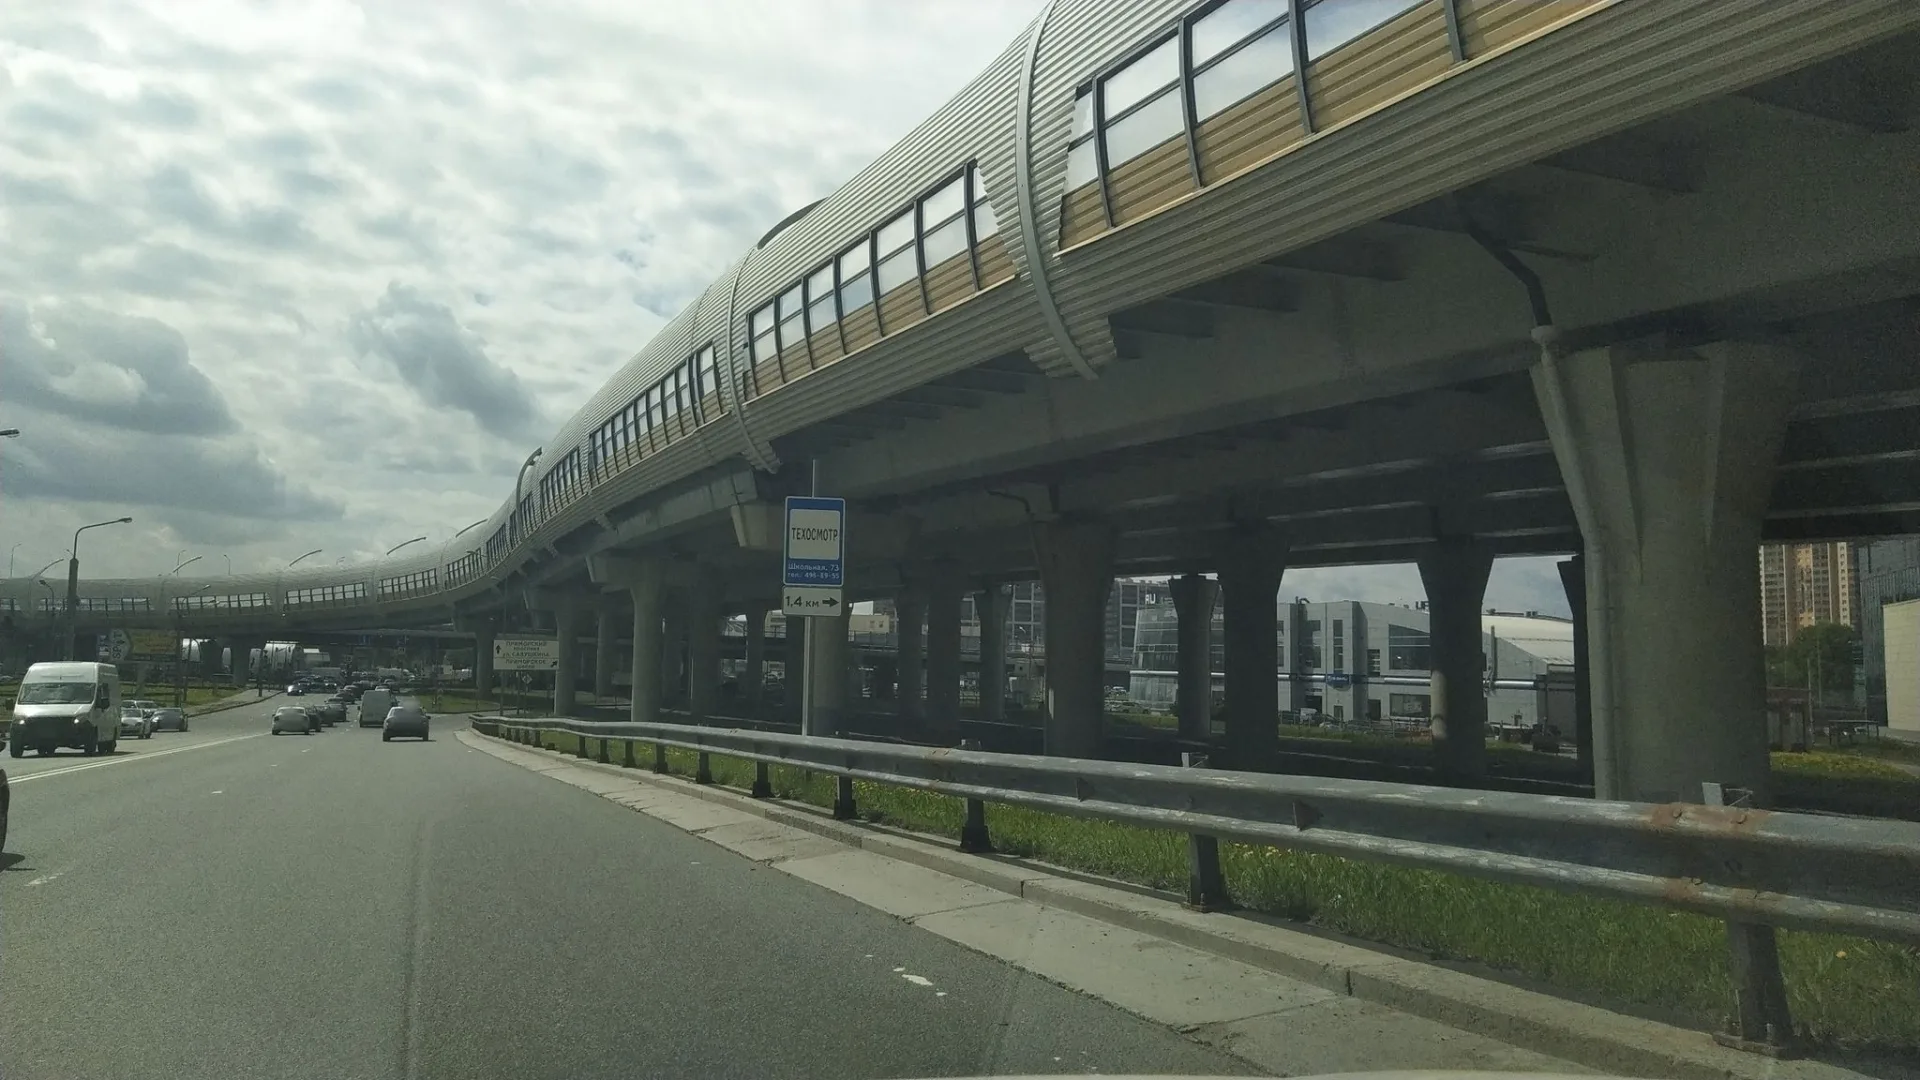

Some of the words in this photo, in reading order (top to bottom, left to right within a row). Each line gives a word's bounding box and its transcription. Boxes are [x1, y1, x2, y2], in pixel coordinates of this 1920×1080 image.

[791, 527, 838, 541] ТЕХОСМОТР
[830, 564, 840, 572] 73
[785, 595, 802, 607] 1,4
